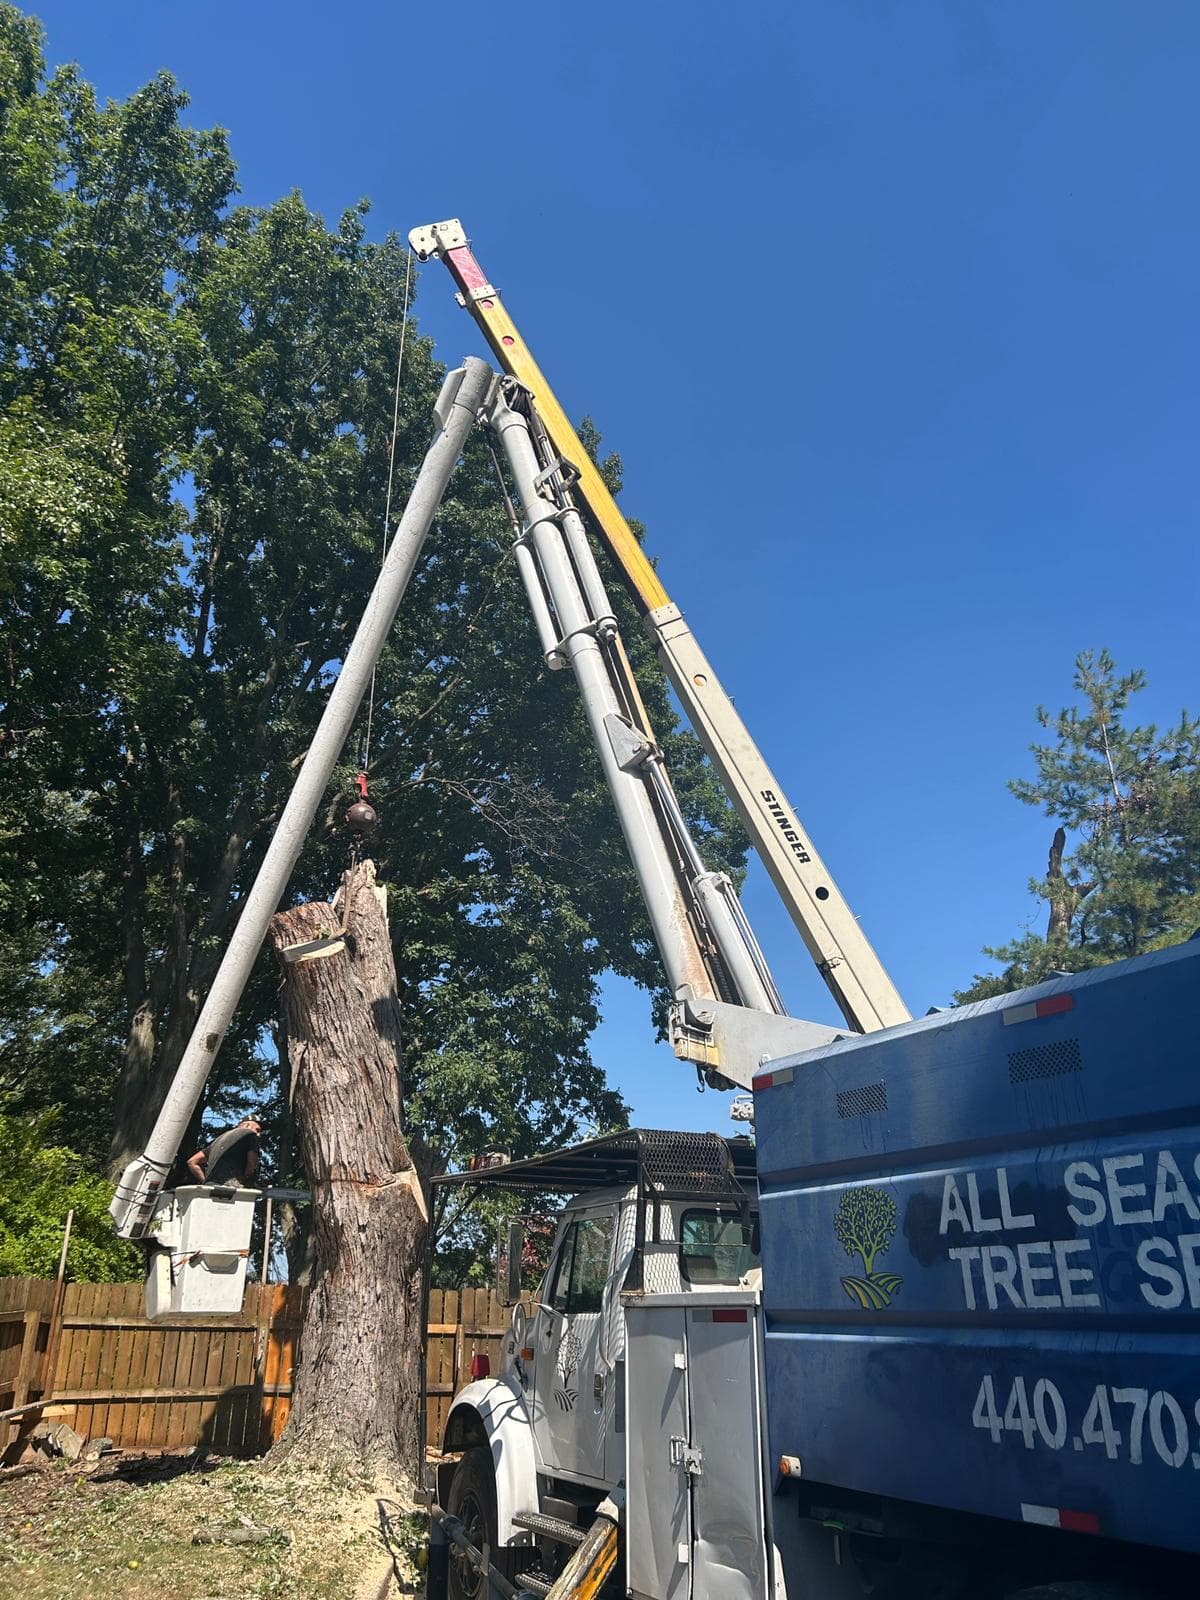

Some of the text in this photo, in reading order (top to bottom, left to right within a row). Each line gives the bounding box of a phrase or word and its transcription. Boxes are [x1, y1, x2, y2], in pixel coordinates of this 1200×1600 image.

[760, 790, 811, 864] STINGER
[939, 1150, 1200, 1235] ALL SEA
[948, 1239, 1101, 1310] TREE
[972, 1374, 1200, 1470] 440.470.
